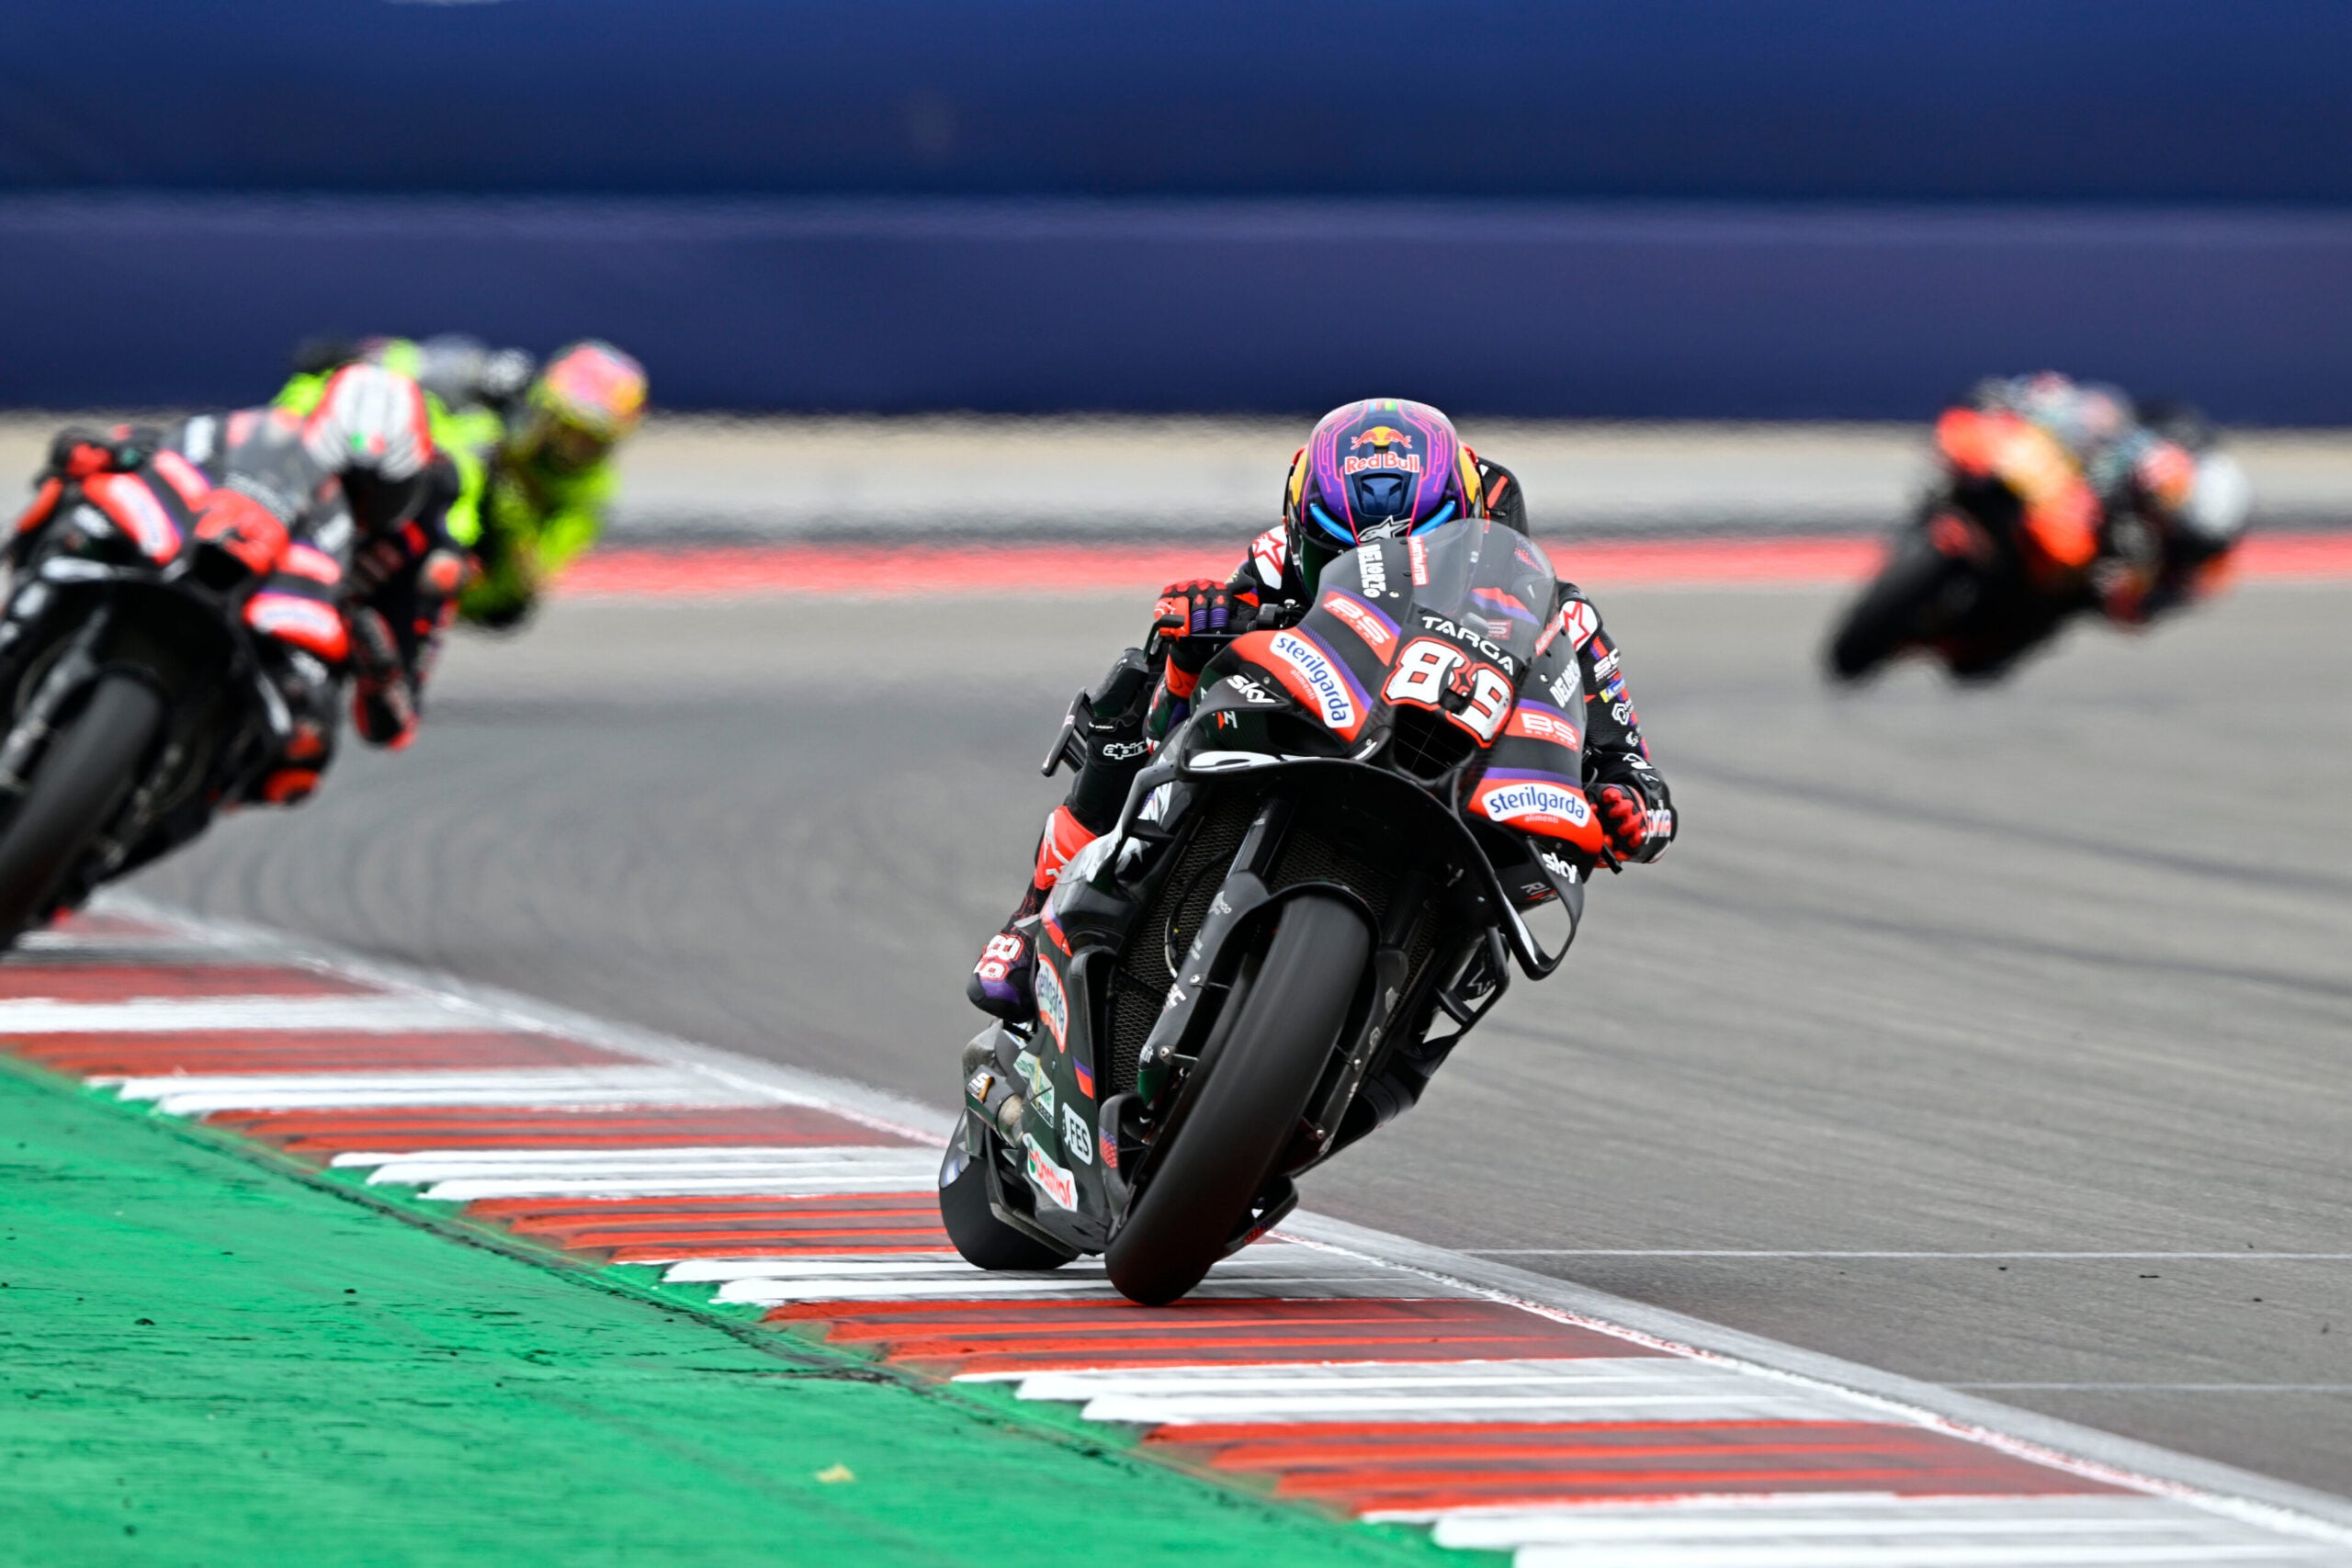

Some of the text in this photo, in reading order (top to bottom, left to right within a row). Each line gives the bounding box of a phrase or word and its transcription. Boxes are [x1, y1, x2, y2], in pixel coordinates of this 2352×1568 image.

[1344, 452, 1419, 474] Red Bull
[1329, 597, 1391, 644] BS
[1421, 615, 1514, 676] TARGA
[1227, 674, 1276, 704] sky
[1277, 637, 1350, 722] sterilgarda
[1289, 669, 1317, 701] alimenti
[1385, 640, 1512, 741] 89
[1521, 712, 1577, 744] BS
[1488, 786, 1585, 820] sterilgarda
[1524, 815, 1559, 824] alimenti
[1542, 852, 1577, 884] sky
